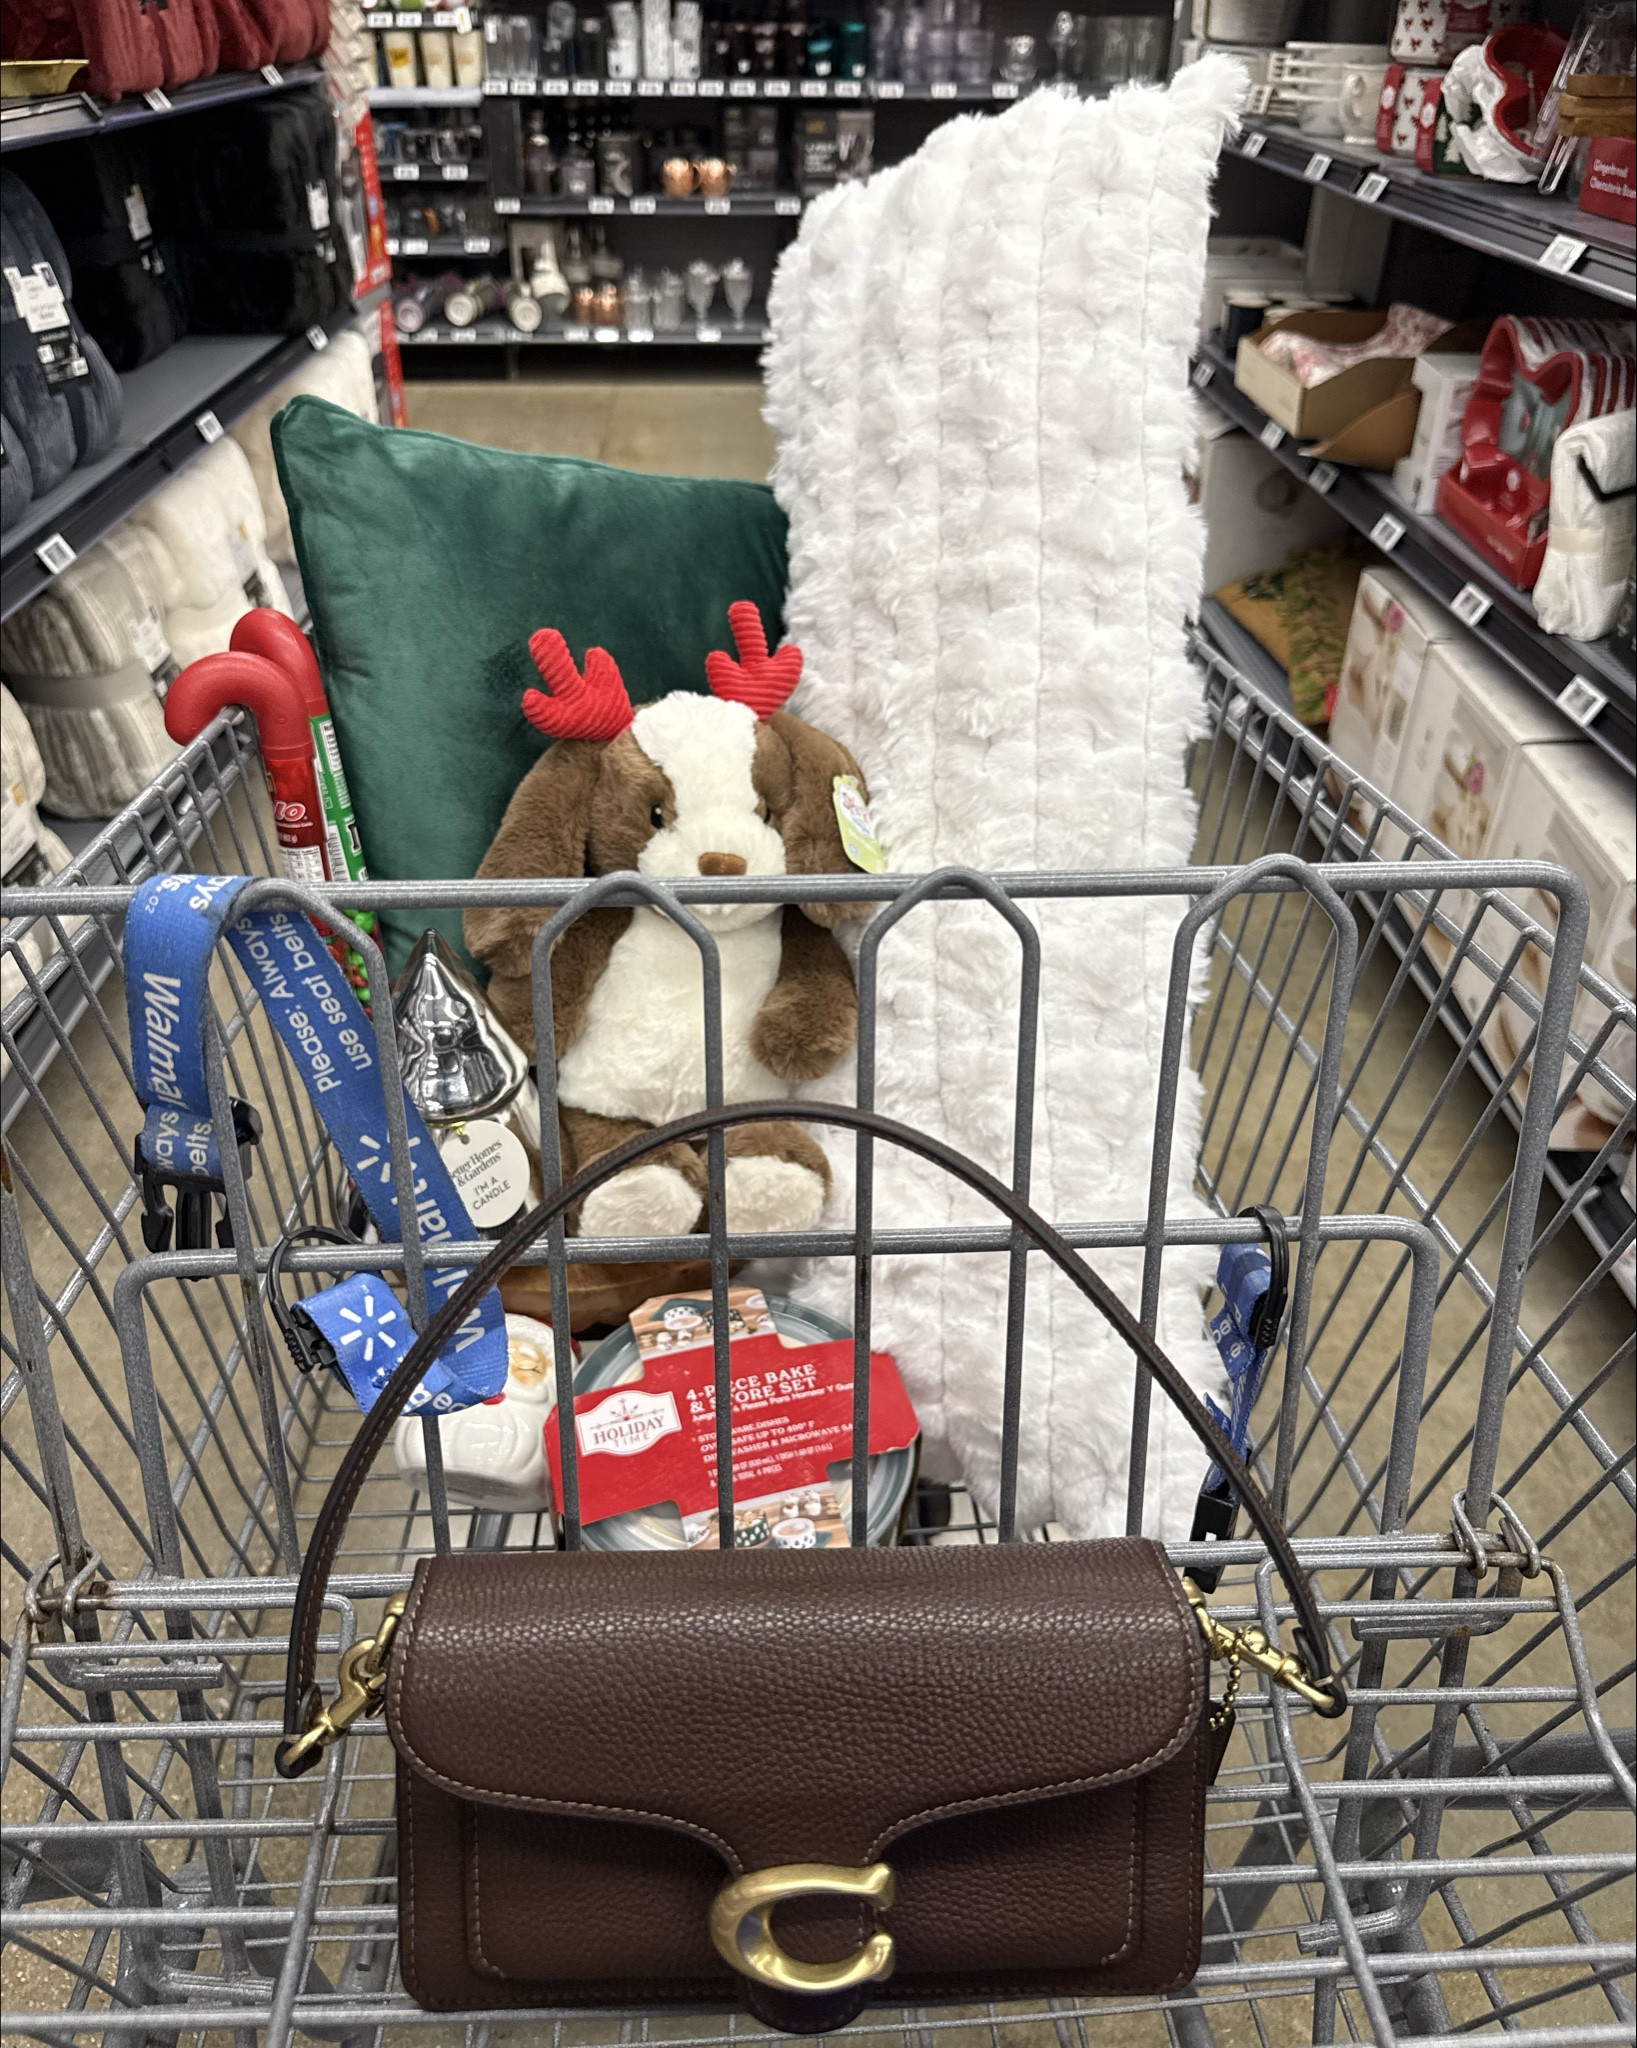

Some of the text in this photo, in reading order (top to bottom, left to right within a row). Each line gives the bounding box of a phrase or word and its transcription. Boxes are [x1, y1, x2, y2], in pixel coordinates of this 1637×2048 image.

[236, 917, 342, 1093] Please: Always
[301, 974, 348, 1025] seat
[338, 1028, 373, 1071] use
[452, 1140, 502, 1178] etter Homes
[472, 1180, 511, 1209] CANDLE
[474, 1176, 499, 1196] I'M A
[686, 1363, 817, 1401] 4-PCE BAKE
[690, 1375, 817, 1414] & SORE SET
[594, 1415, 664, 1445] HOLIDAY
[614, 1432, 650, 1448] TIME
[697, 1415, 790, 1443] STOWARE DISHES
[755, 1430, 770, 1441] UP
[771, 1426, 785, 1437] TO
[780, 1426, 841, 1445] MICROWAVE
